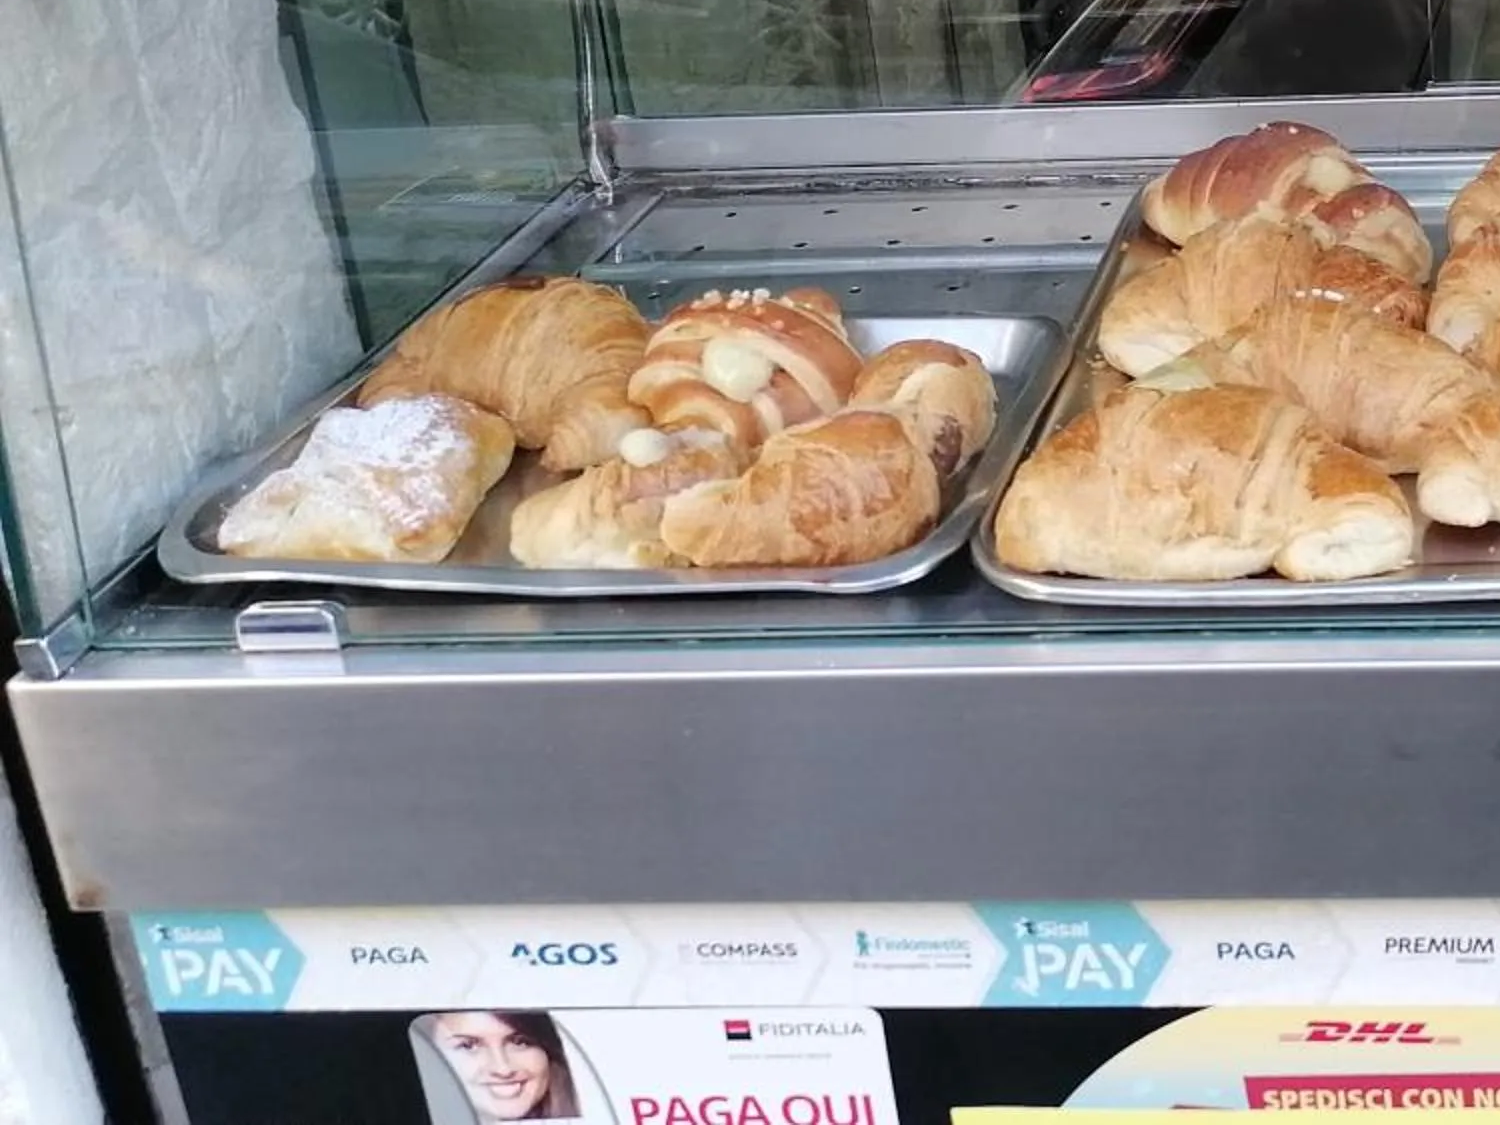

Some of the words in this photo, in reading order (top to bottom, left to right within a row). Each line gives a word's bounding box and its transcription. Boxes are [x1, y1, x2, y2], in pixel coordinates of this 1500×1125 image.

[173, 926, 224, 944] Sisal
[1036, 921, 1089, 938] Sisal
[351, 946, 429, 965] PAGA
[697, 942, 798, 958] COMPASS
[1217, 942, 1295, 961] PAGA
[1385, 937, 1495, 955] PREMIUM
[161, 948, 283, 996] PAY
[1023, 943, 1147, 996] PAY
[758, 1022, 866, 1037] FIDITALIA
[1305, 1021, 1434, 1044] DHL
[1263, 1087, 1393, 1109] SPEDISCI
[1402, 1087, 1463, 1109] CON
[631, 1095, 771, 1125] PAGA
[782, 1094, 875, 1125] QUI
